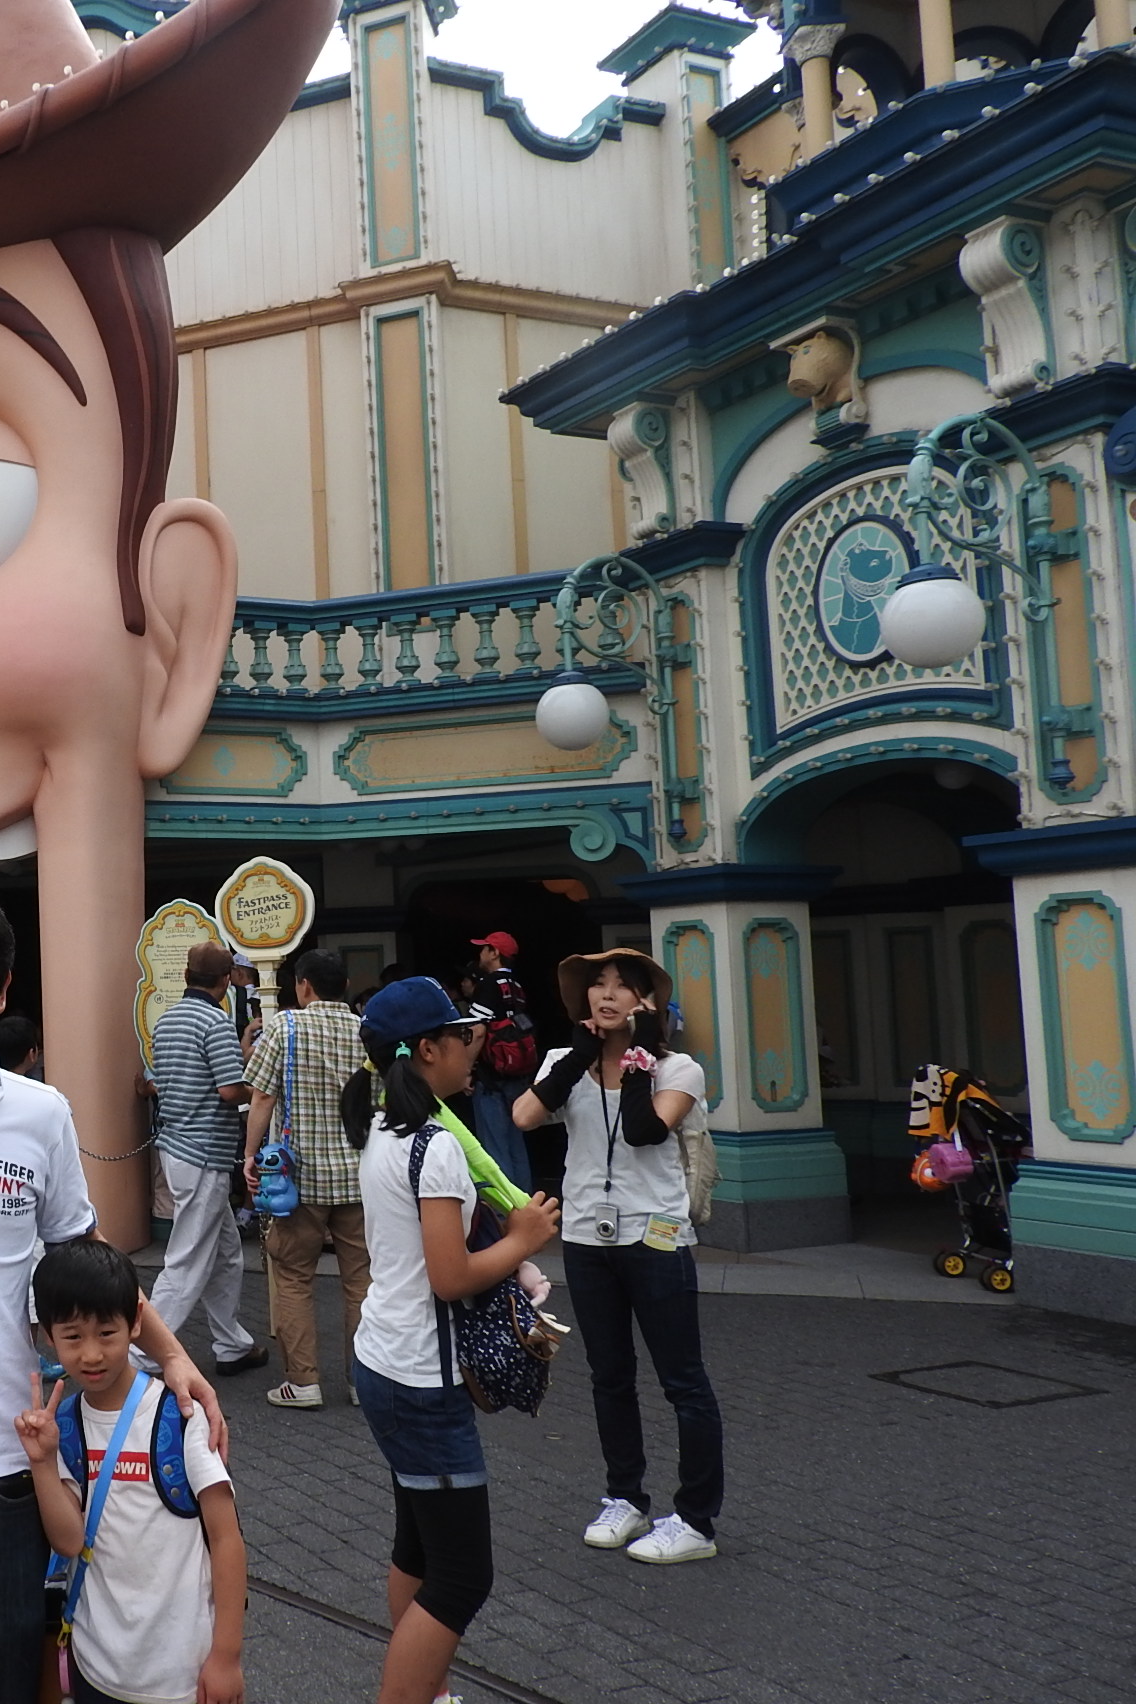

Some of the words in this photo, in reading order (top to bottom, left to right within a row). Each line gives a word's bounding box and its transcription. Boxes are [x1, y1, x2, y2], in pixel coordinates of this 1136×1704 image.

[237, 893, 289, 909] FASTPASS
[236, 901, 292, 921] ENTRANCE
[250, 921, 281, 933] エントランス
[2, 1197, 27, 1209] 1985
[14, 1208, 30, 1217] CITY
